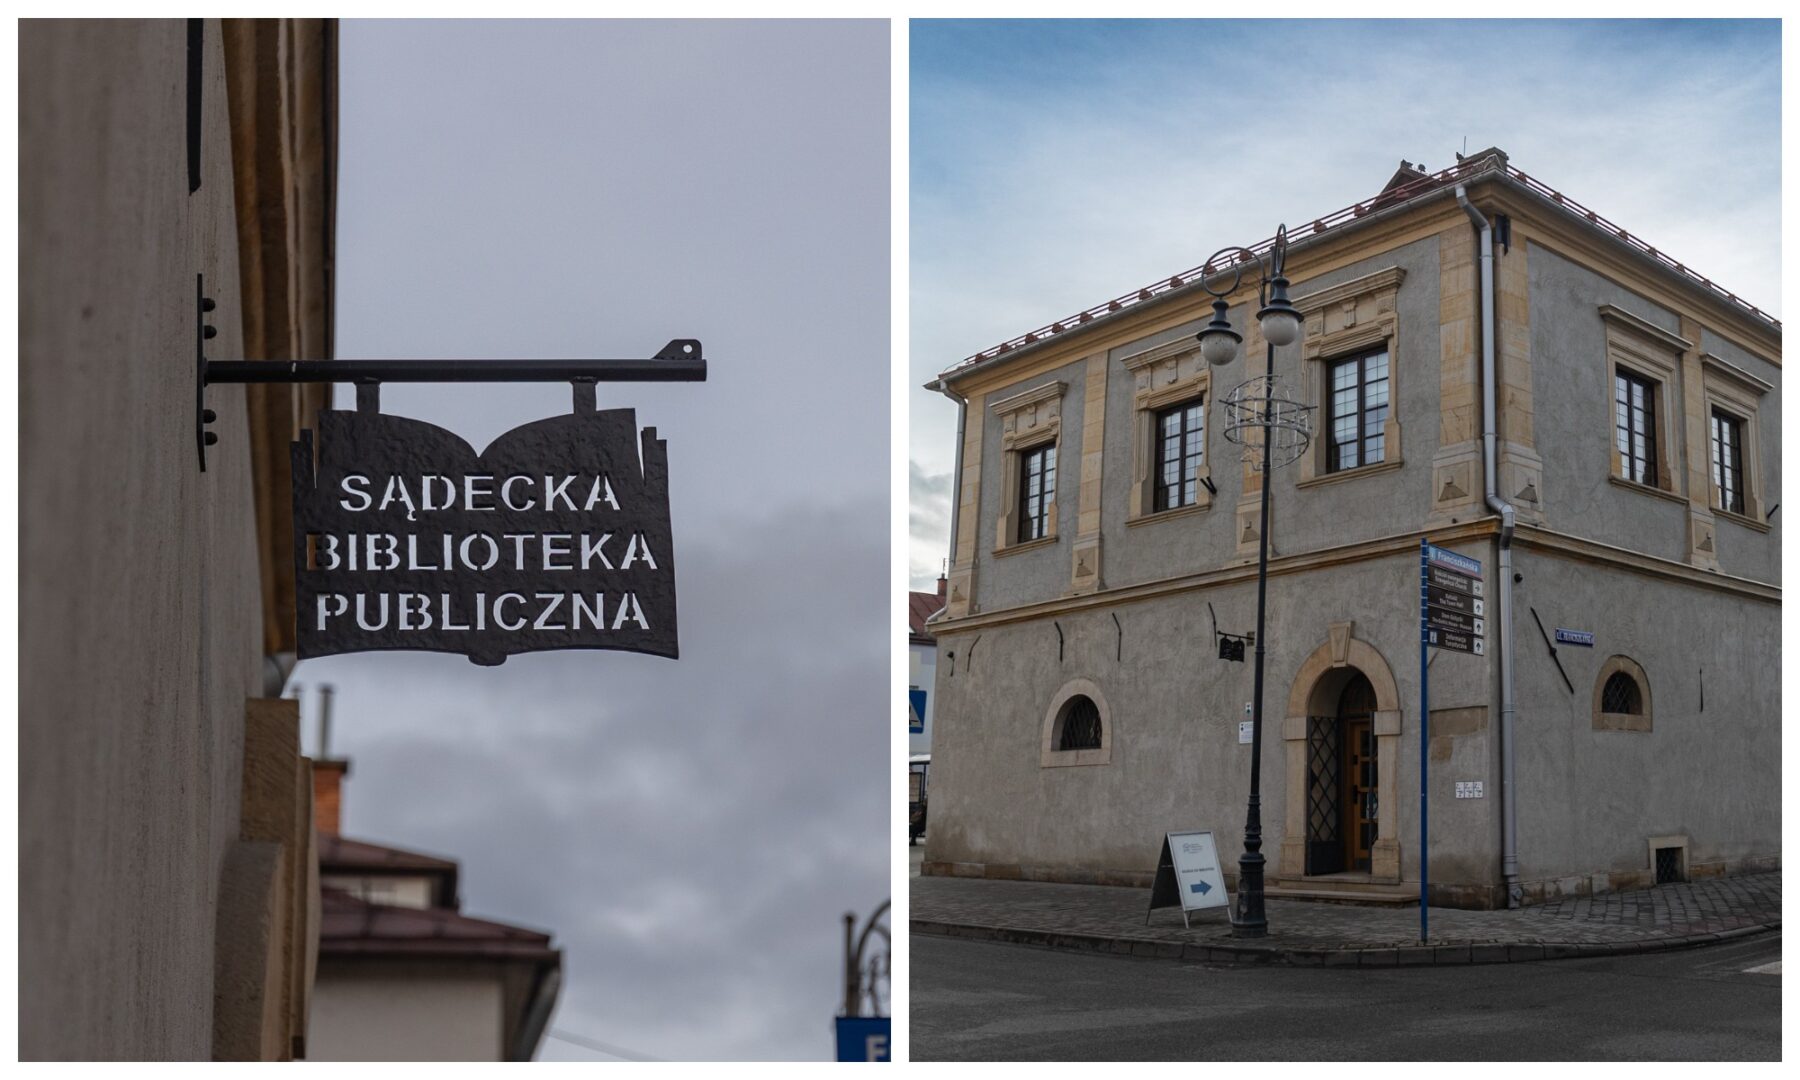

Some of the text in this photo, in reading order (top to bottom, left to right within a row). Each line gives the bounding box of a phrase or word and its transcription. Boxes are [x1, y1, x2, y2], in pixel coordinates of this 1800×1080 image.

[340, 474, 621, 521] SĄDECKA
[306, 533, 658, 571] BIBLIOTEKA
[317, 592, 650, 630] PUBLICZNA
